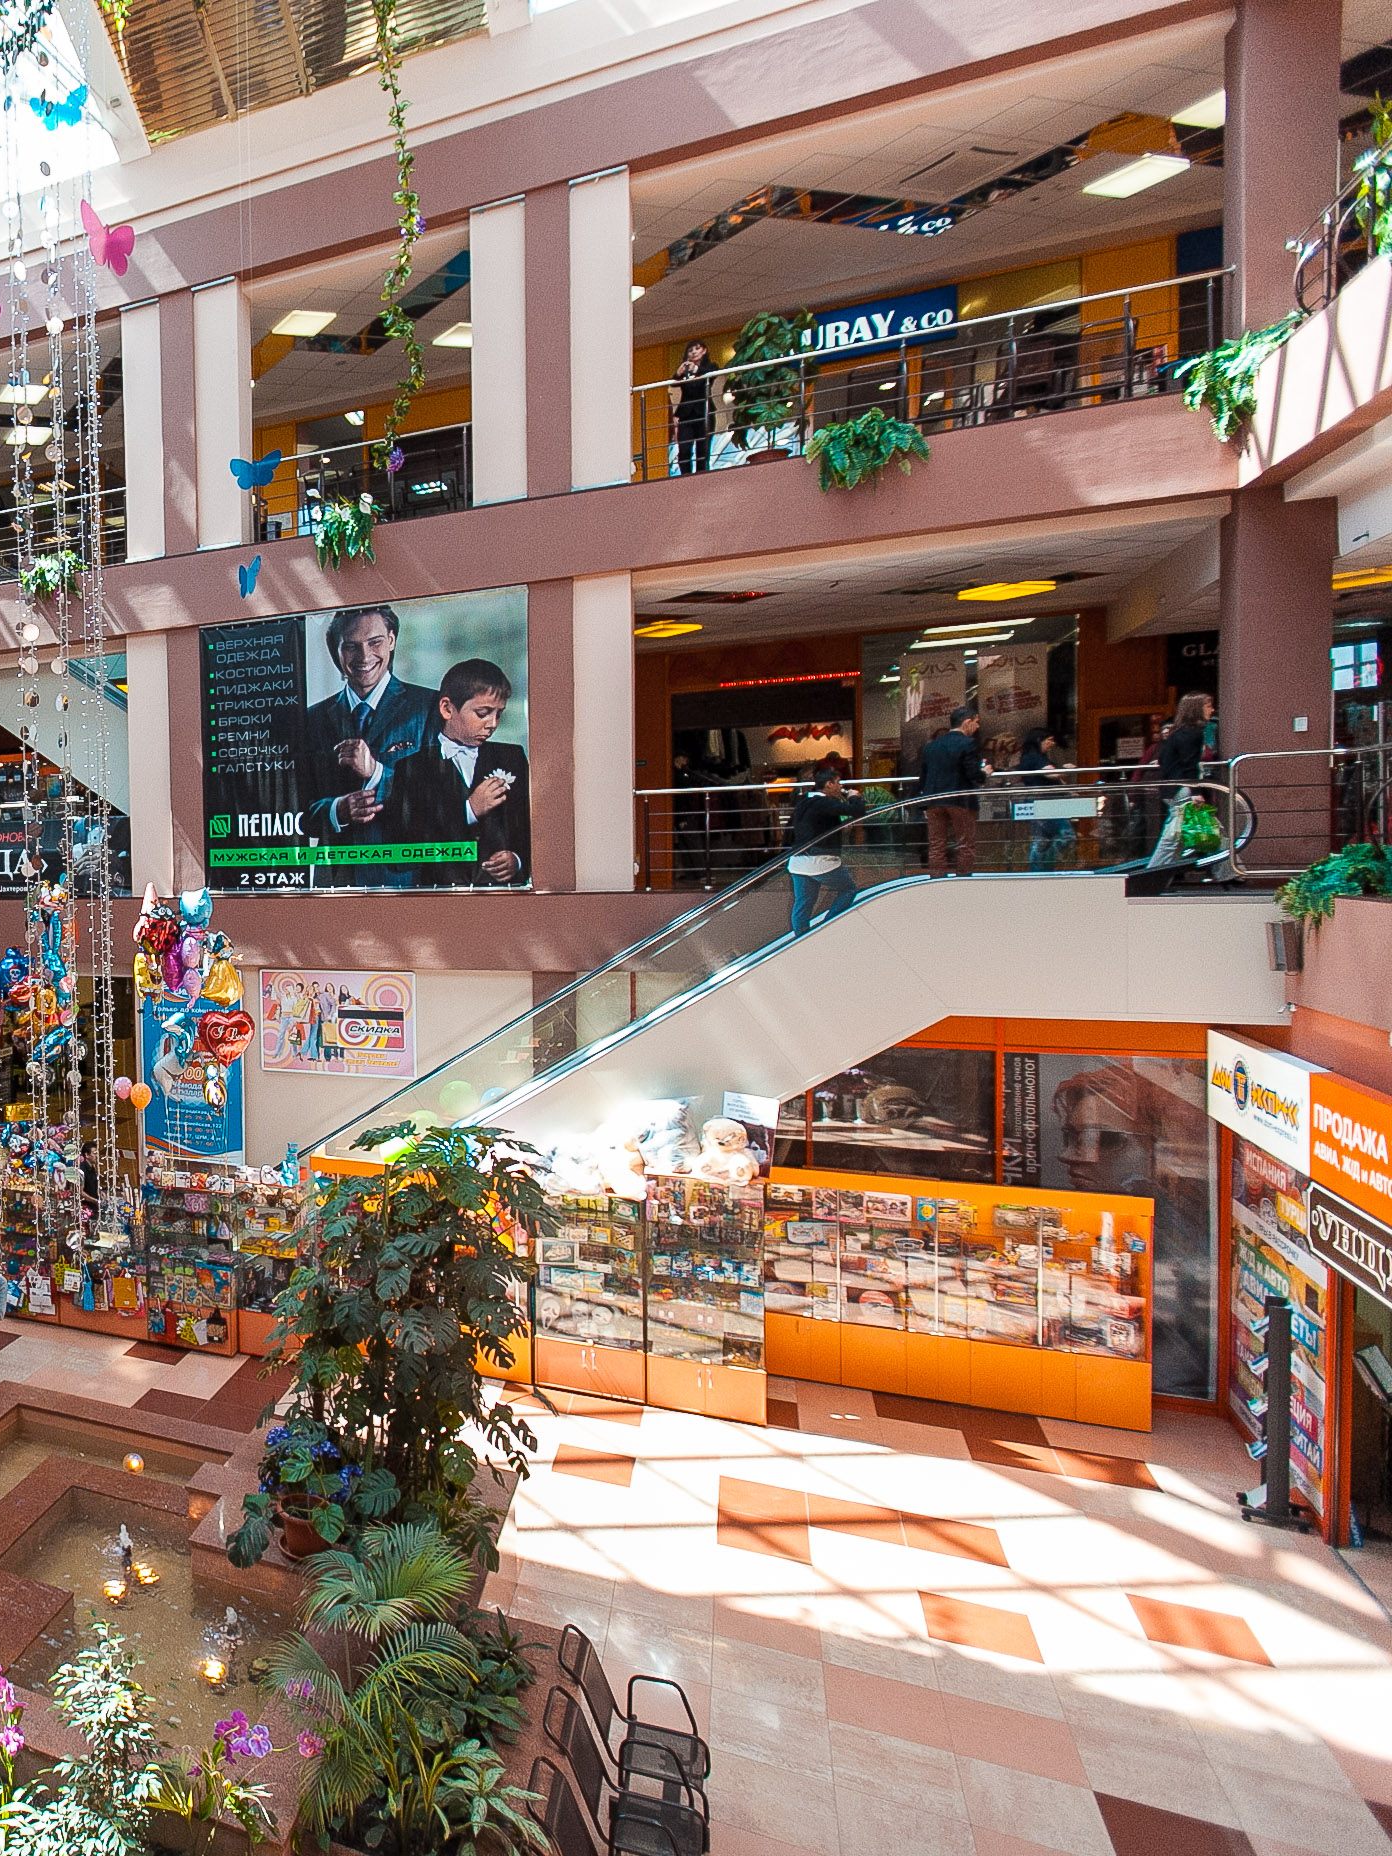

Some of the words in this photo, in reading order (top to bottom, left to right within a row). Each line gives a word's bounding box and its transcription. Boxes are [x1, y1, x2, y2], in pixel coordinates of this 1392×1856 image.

[900, 316, 917, 333] &
[921, 308, 954, 328] CO
[215, 634, 285, 651] ВЕРХНЯЯ
[216, 648, 281, 665] ОДЕЖДА
[215, 663, 294, 680] КОСТЮМЫ
[216, 679, 294, 697] ПИДЖАКИ
[216, 695, 299, 711] ТРИКОТАЖ
[217, 714, 272, 727] БРЮКИ
[217, 729, 270, 742] РЕМНИ
[218, 745, 290, 758] СОРОЧКИ
[217, 760, 295, 774] ГАЛСТУКИ
[238, 811, 305, 838] ПЕПЛОС
[213, 850, 289, 862] МУЖСКАЯ
[297, 850, 307, 860] И
[315, 849, 393, 861] ДЕТСКАЯ
[401, 847, 475, 859] ОДЕЖДА
[241, 874, 251, 885] 2
[254, 872, 305, 885] ЭТАЖ
[349, 1025, 400, 1034] СКИДКА
[1313, 1103, 1388, 1164] ПРОДАЖА
[1314, 1141, 1340, 1172] АВИА,
[1245, 1147, 1287, 1191] ИСПАНИЯ
[1264, 1264, 1288, 1297] АВТО
